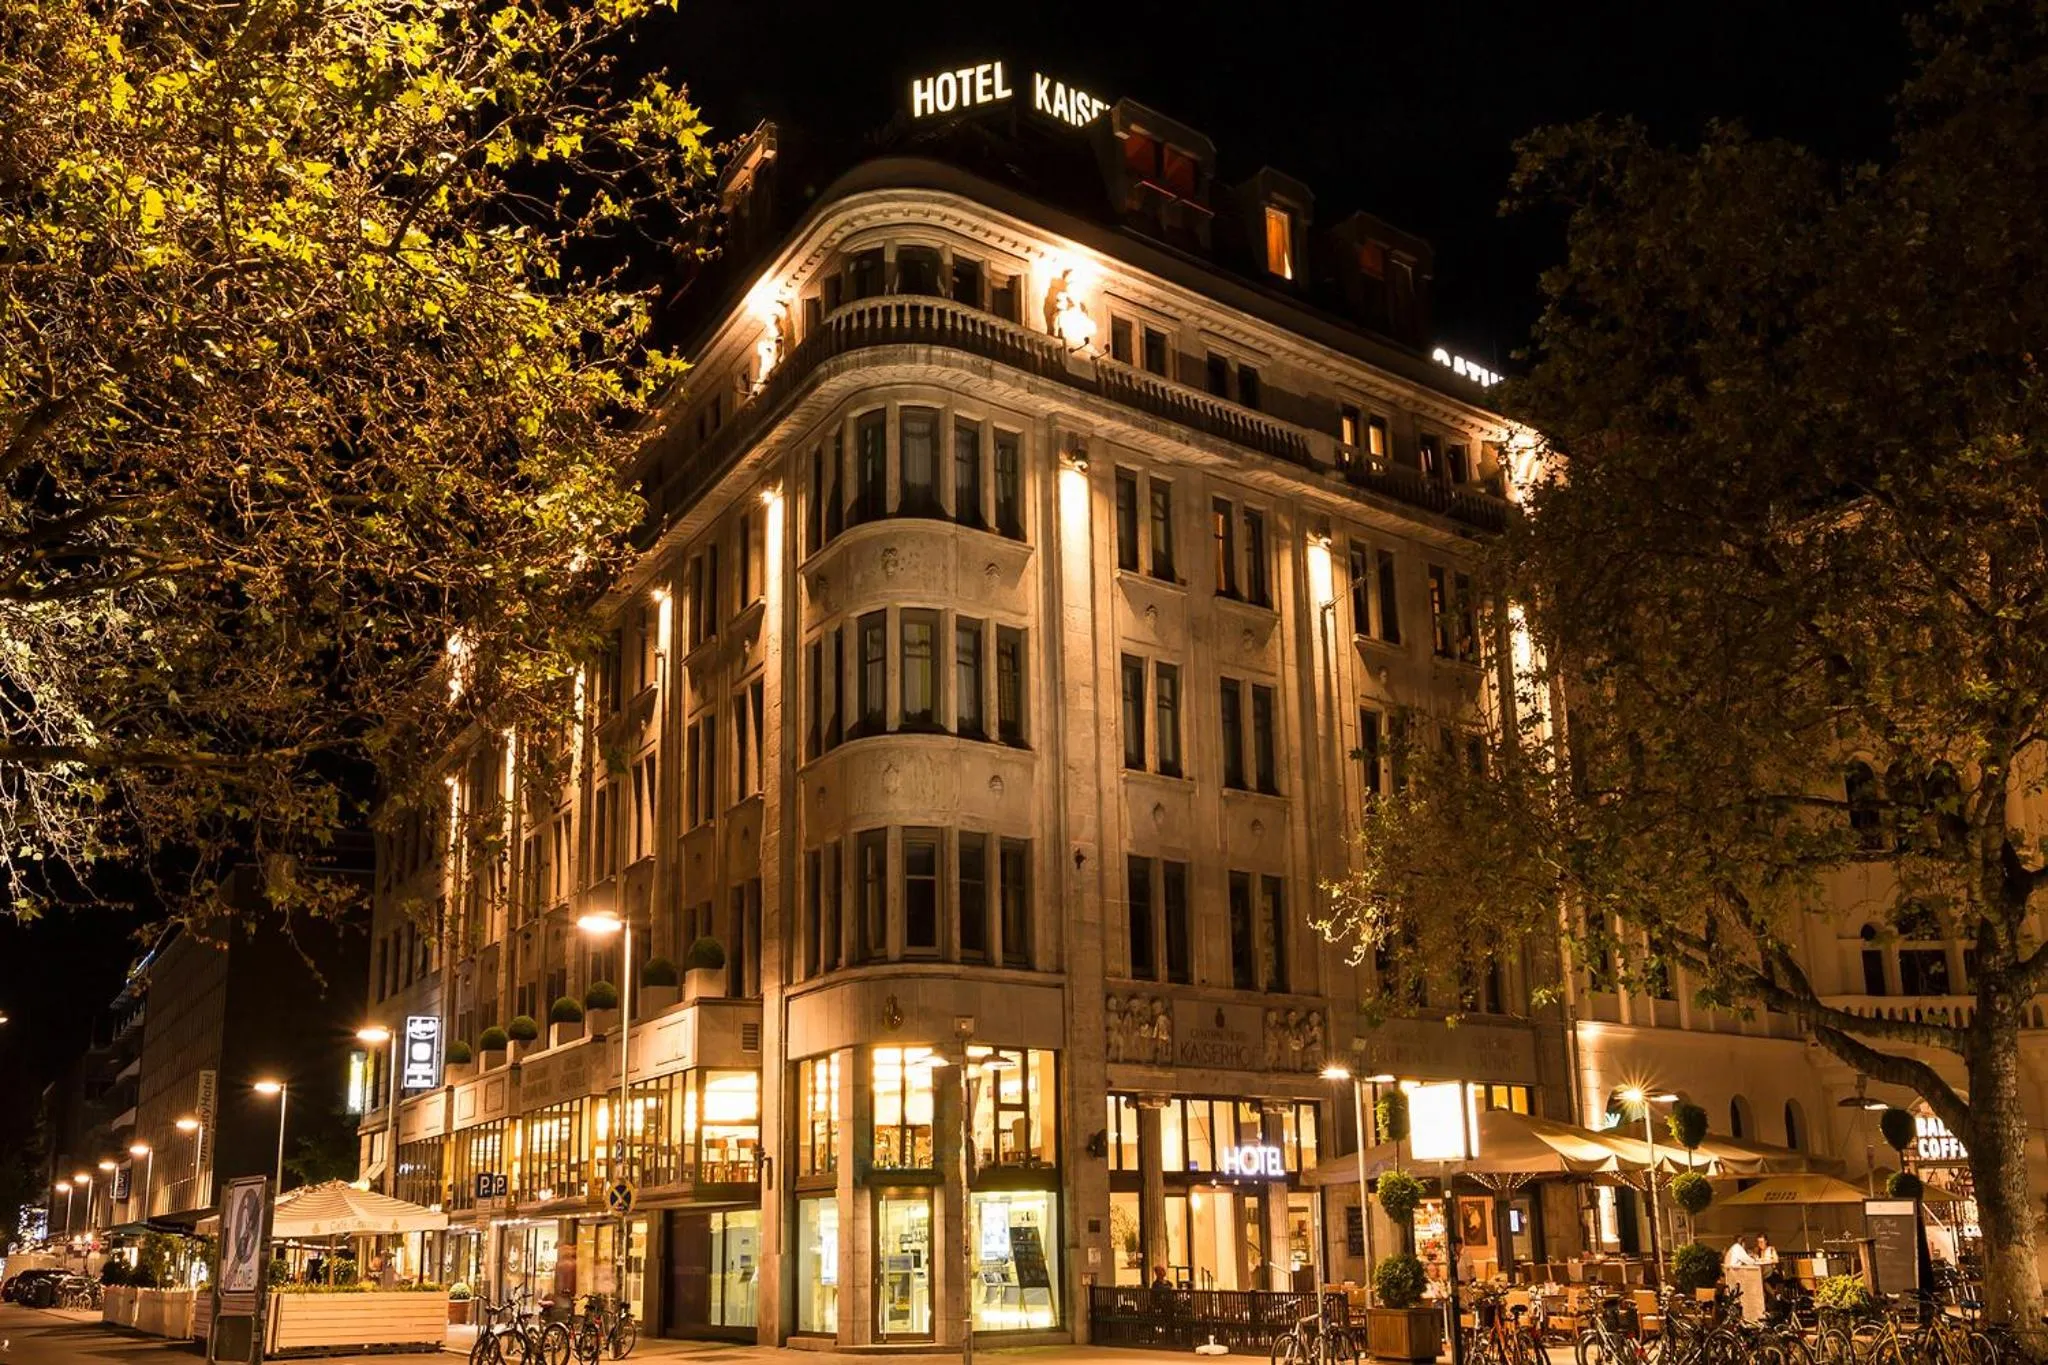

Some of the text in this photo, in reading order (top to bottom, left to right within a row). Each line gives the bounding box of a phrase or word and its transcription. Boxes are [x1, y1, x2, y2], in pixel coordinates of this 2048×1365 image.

[913, 61, 1012, 117] HOTEL
[1223, 1146, 1285, 1176] HOTEL
[480, 1176, 490, 1197] P
[496, 1177, 505, 1195] P
